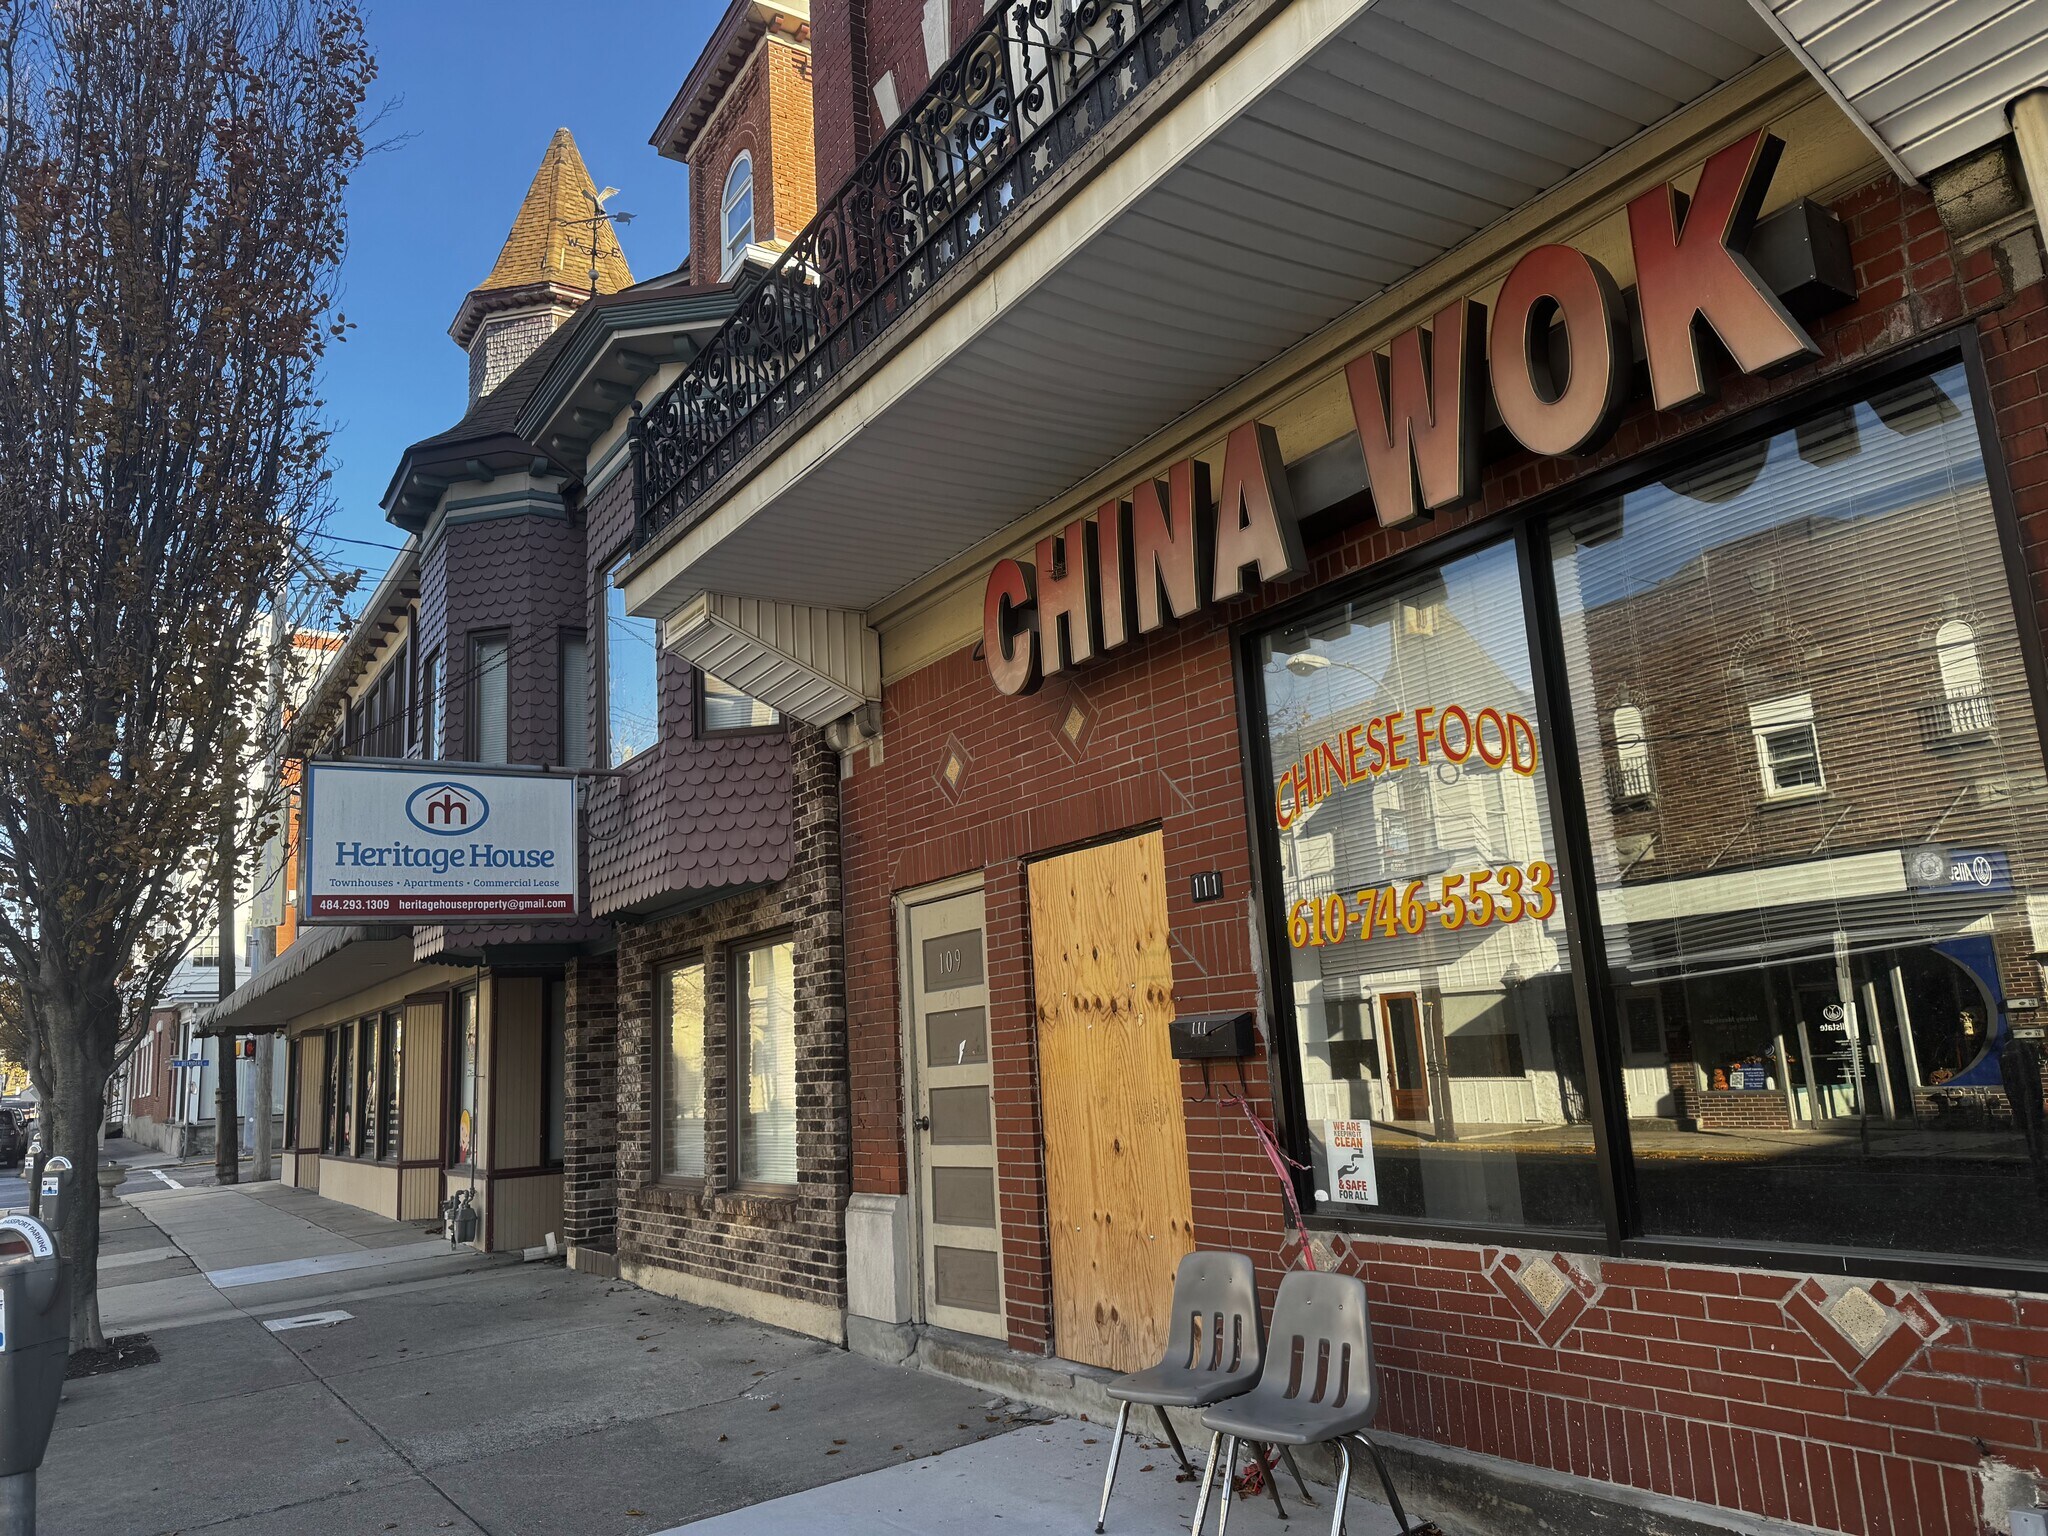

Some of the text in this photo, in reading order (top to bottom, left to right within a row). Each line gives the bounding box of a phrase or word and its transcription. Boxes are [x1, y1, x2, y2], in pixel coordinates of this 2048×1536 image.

[983, 126, 1818, 697] CHINA WOK
[1275, 704, 1539, 831] CHINESE FOOD
[335, 841, 555, 874] Heritage House
[329, 878, 560, 889] Townhouses Apartments Commercial Lease
[1193, 873, 1220, 898] 111
[319, 898, 567, 912] 484.293.1309 heritagehouseproperty@gmail.com
[1287, 861, 1556, 949] 610-746-5533
[939, 948, 962, 974] 109
[1191, 1021, 1208, 1035] 111
[1333, 1121, 1361, 1132] WE ARE
[1334, 1136, 1363, 1148] CLEAN
[1338, 1179, 1368, 1191] & SAFE
[1338, 1189, 1369, 1201] FOR ALL
[27, 1225, 48, 1253] PARKING
